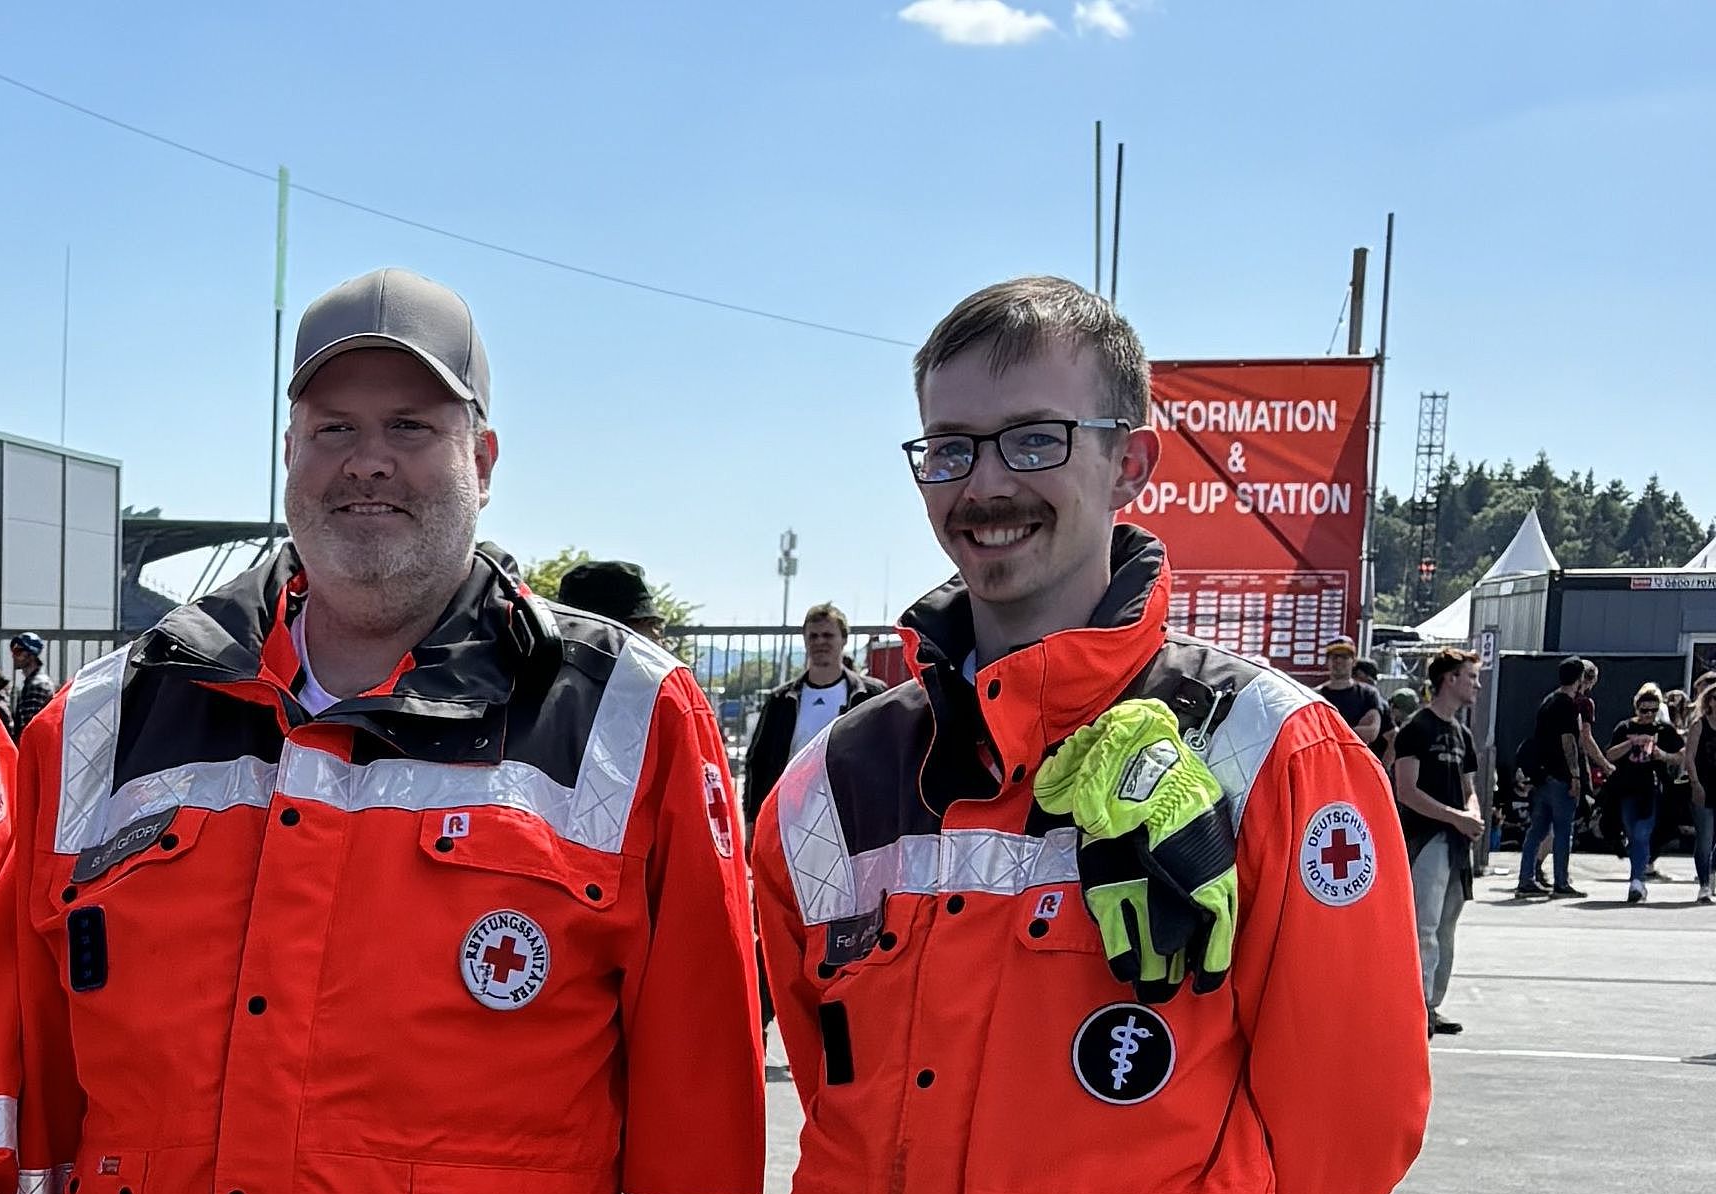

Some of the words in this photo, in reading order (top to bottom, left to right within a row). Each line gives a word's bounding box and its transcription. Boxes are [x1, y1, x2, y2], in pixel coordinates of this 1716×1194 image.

[1227, 441, 1246, 473] &
[1125, 482, 1227, 514] OP-UP
[1235, 482, 1351, 515] STATION
[1308, 811, 1366, 847] DEUTSCHES
[1307, 859, 1338, 896] ROTES
[1344, 854, 1372, 896] KREUZ
